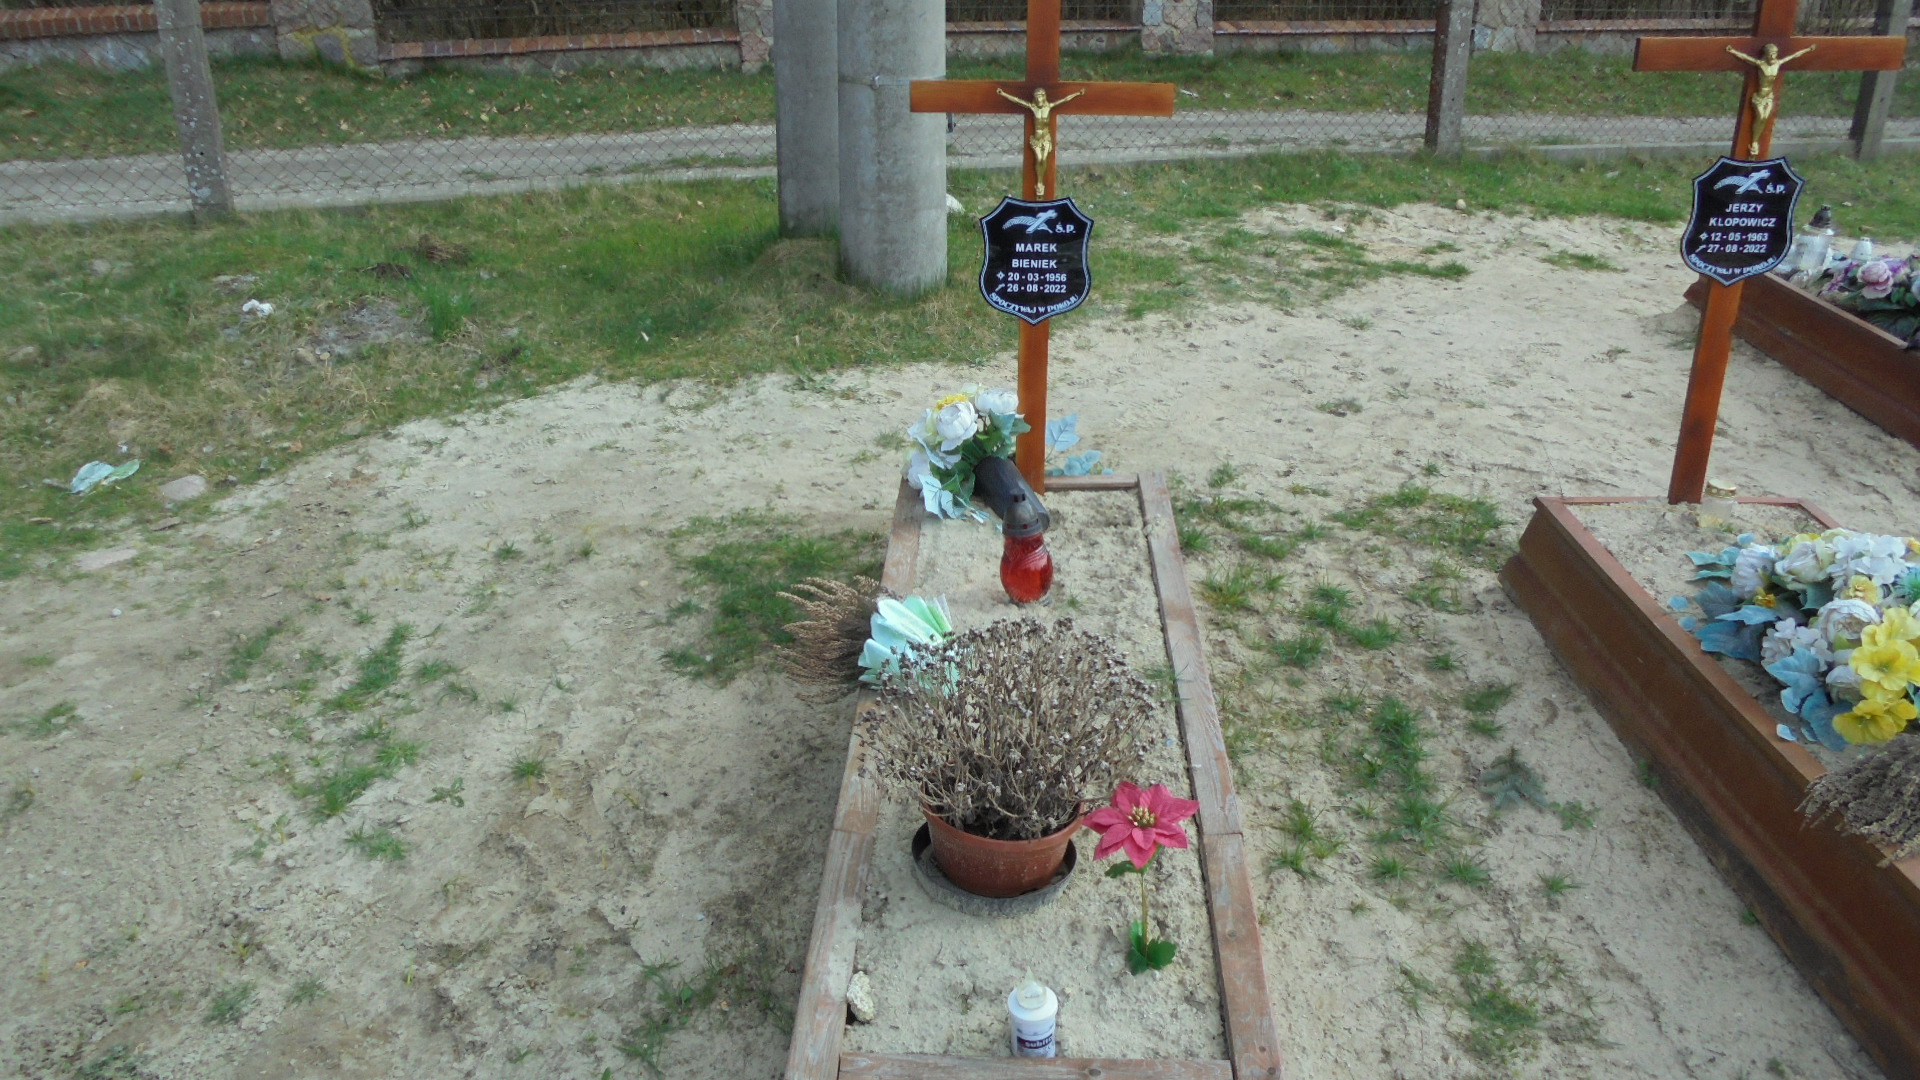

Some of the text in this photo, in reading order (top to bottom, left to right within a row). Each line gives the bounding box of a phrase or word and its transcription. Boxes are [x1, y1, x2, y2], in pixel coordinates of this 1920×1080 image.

[1725, 203, 1763, 213] JERZY
[1709, 217, 1776, 227] KLOPOWICZ
[1016, 243, 1057, 252] MAREK
[1012, 259, 1057, 268] BIENIEK
[1734, 267, 1742, 275] W
[990, 292, 1036, 313] SPOCZYWAJ
[1047, 294, 1079, 313] POKOJU
